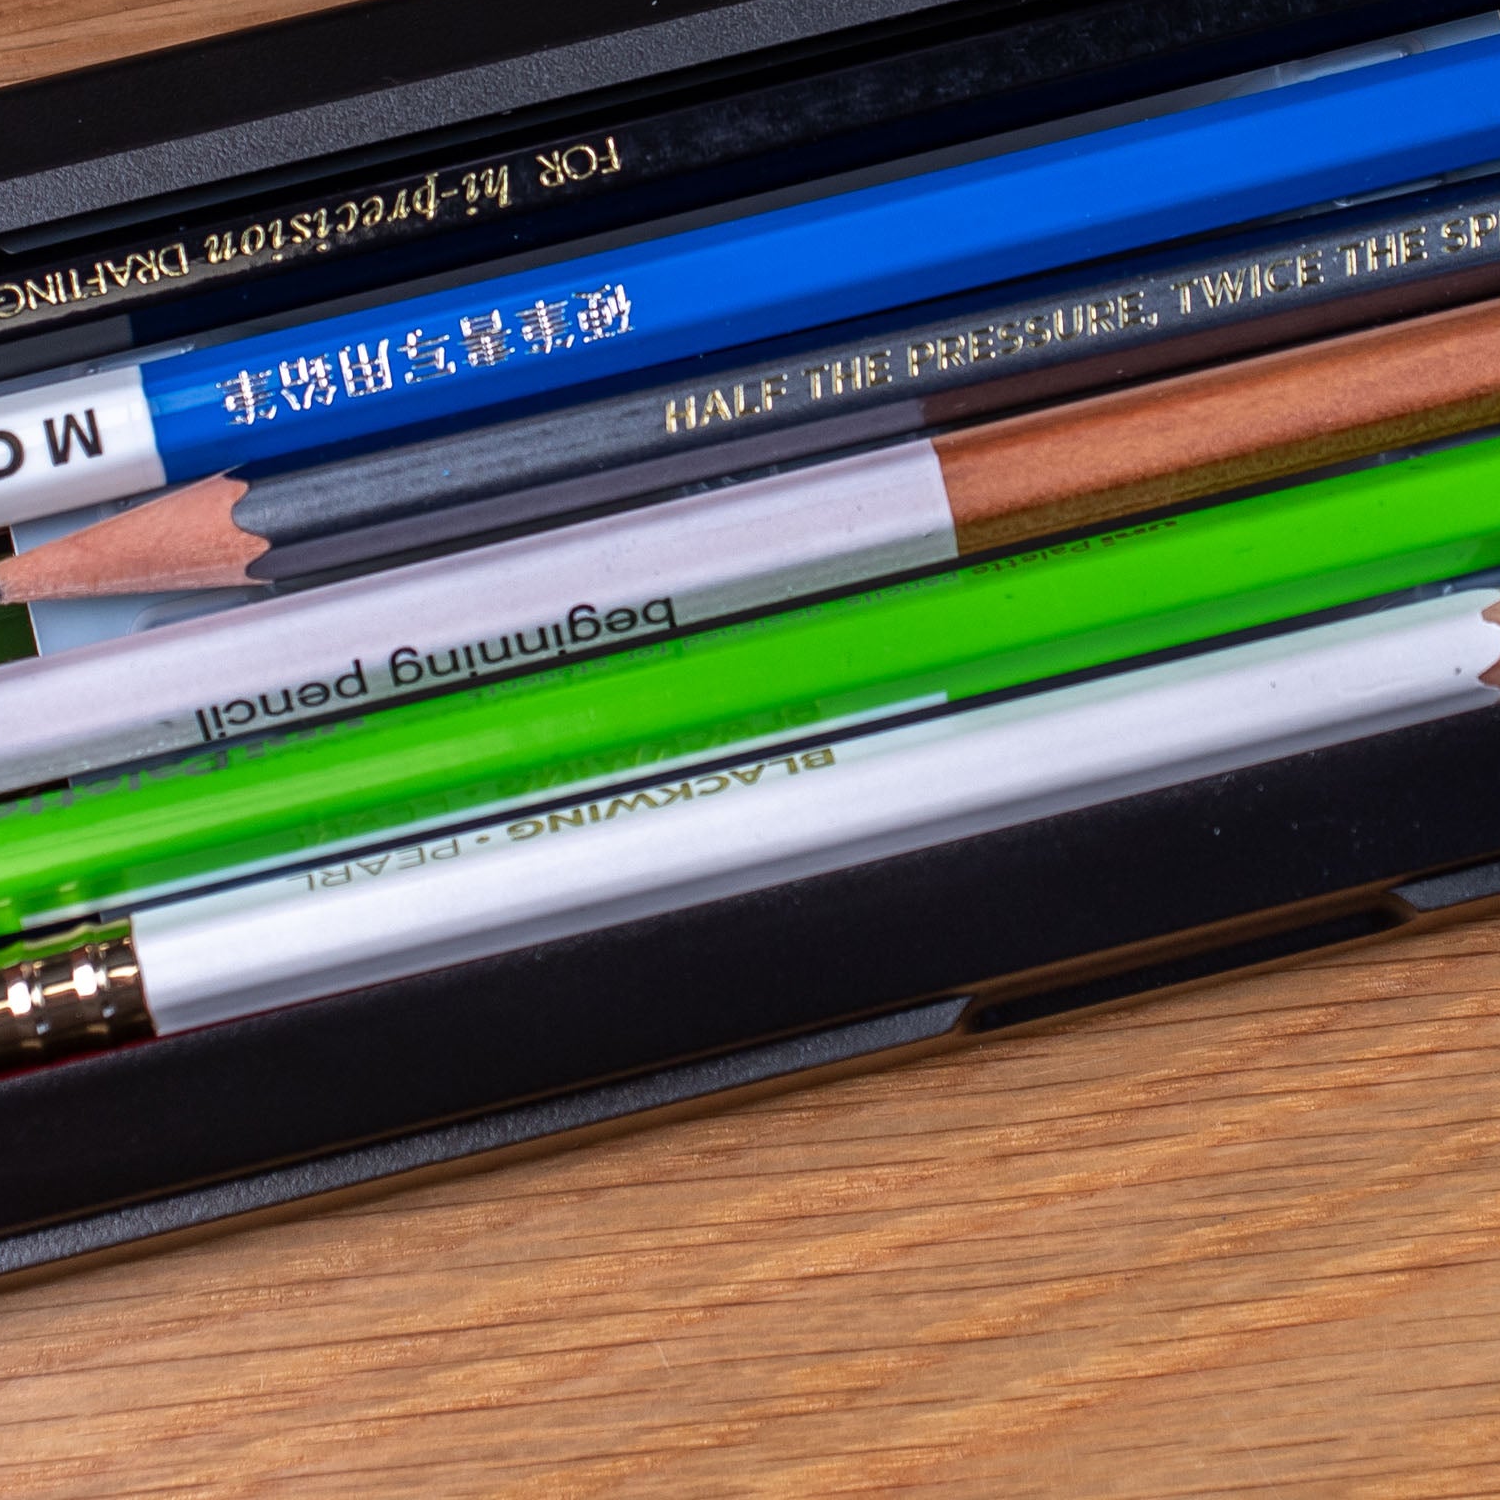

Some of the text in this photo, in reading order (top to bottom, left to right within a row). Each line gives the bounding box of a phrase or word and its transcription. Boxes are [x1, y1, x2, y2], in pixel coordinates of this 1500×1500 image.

[206, 159, 511, 264] hi-precision
[536, 136, 624, 188] FOR
[664, 374, 788, 436] HALF
[802, 351, 892, 400] THE
[906, 292, 1161, 378] PRESSURE,
[1172, 250, 1325, 314] TWICE
[1334, 226, 1428, 278] THE
[196, 595, 676, 742] beginning pencil
[504, 746, 837, 843] BLACKWING
[291, 835, 463, 892] PEARL
